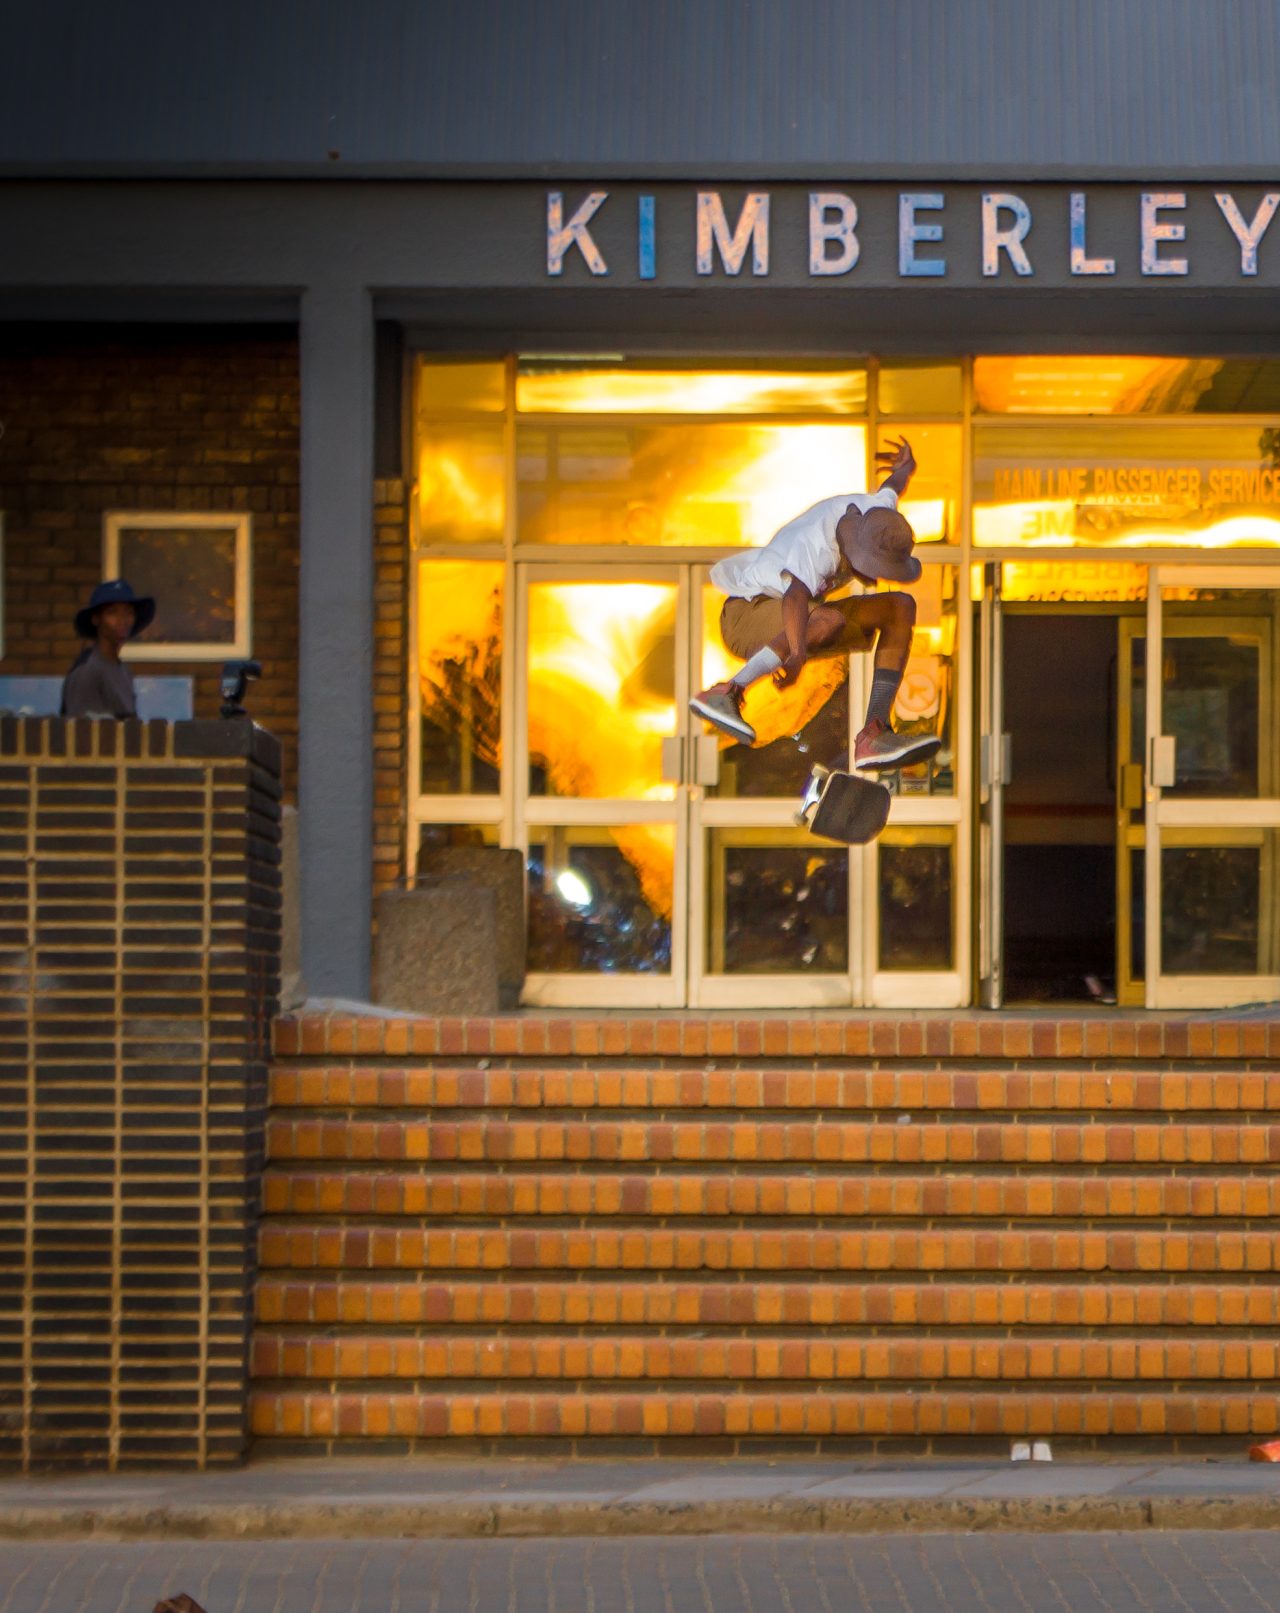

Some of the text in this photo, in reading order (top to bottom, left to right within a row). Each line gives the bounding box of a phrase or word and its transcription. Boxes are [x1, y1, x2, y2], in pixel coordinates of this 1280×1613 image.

[994, 468, 1041, 498] MAIN
[1047, 468, 1087, 499] LINE
[1094, 468, 1201, 501] PASSENGER
